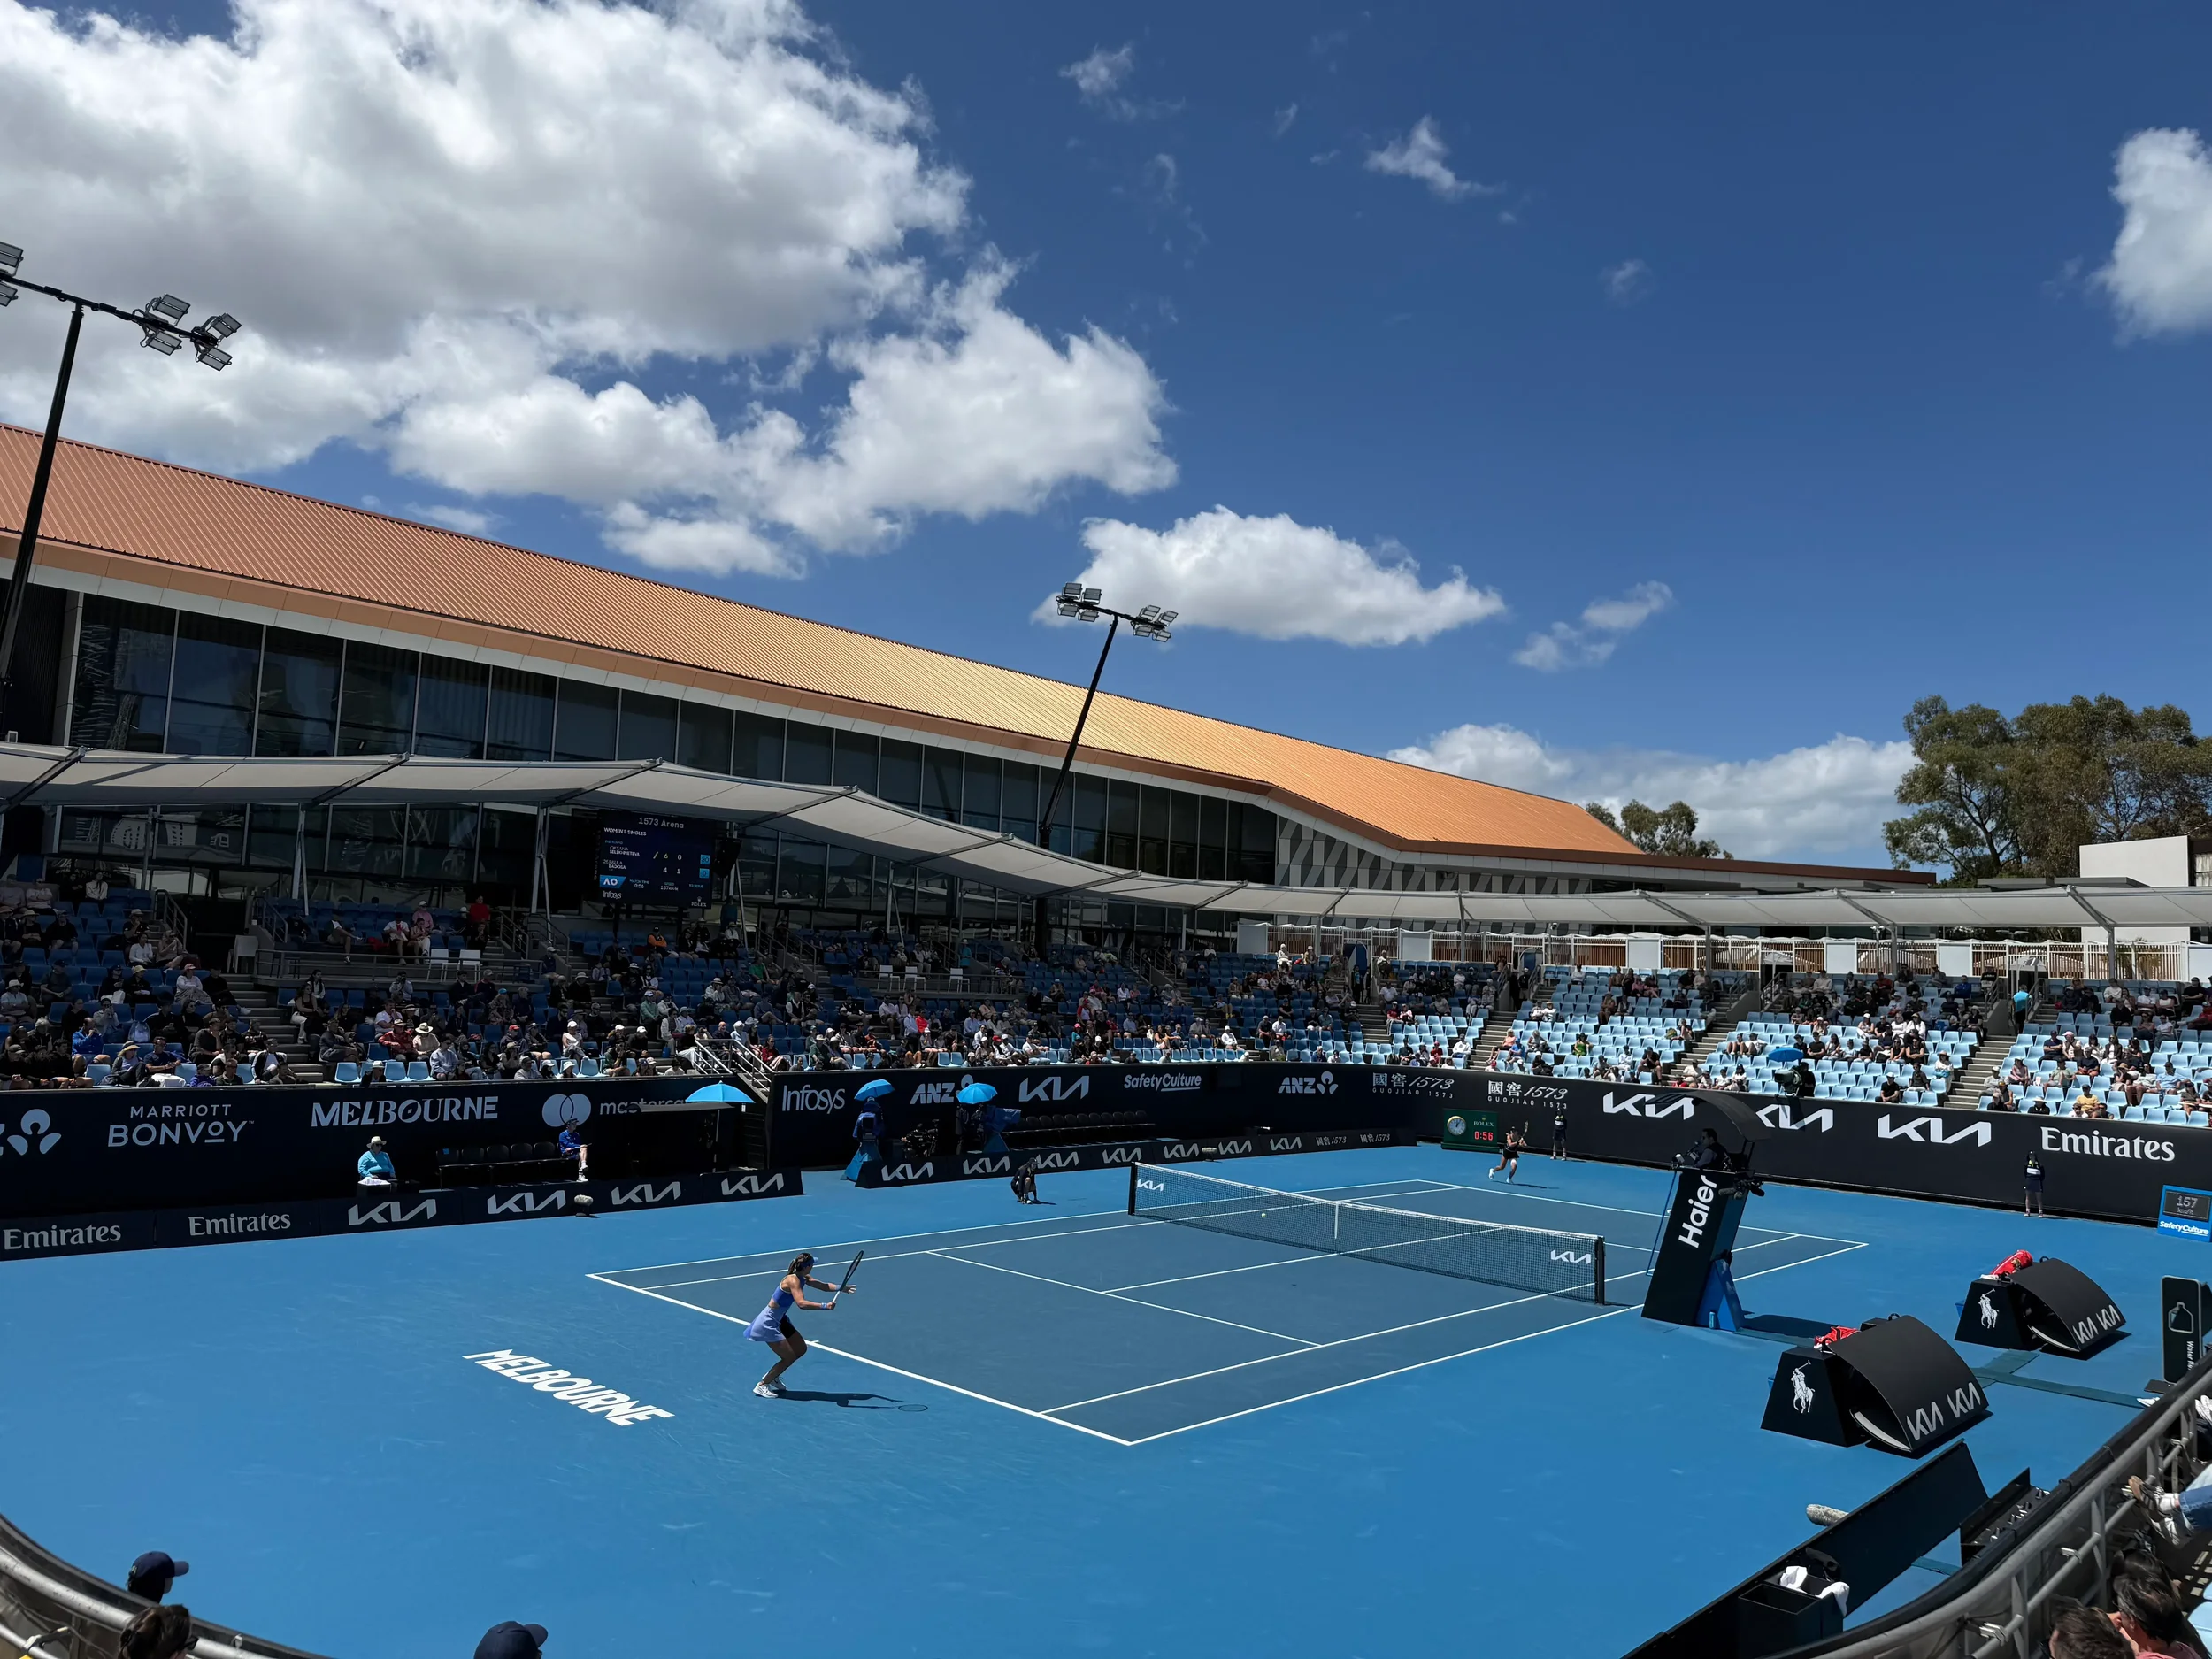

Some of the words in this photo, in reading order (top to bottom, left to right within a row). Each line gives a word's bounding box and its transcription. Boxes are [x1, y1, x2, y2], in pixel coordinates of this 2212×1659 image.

[638, 817, 659, 826] 1573
[660, 819, 684, 829] Arena
[603, 890, 622, 900] Infosys
[1018, 1075, 1090, 1102] KIA
[1124, 1071, 1202, 1093] SafetyCulture
[1278, 1076, 1317, 1094] ANZ
[781, 1083, 846, 1115] Infosys
[910, 1082, 956, 1105] ANZ
[1428, 1090, 1454, 1099] 1573
[1487, 1095, 1535, 1106] GUOJIAO
[1542, 1101, 1568, 1110] 1573
[130, 1104, 232, 1118] MARRIOTT
[311, 1094, 499, 1127] MELBOURNE
[1602, 1091, 1694, 1121] KIA
[1473, 1130, 1494, 1142] 0:56
[1877, 1113, 1992, 1148] KIA
[1102, 1146, 1142, 1164] KIA
[1163, 1142, 1200, 1160] KIA
[1217, 1139, 1252, 1156] KIA
[1269, 1136, 1302, 1152] KIA
[2039, 1126, 2176, 1163] Emirates
[881, 1161, 934, 1182] KIA
[962, 1156, 1011, 1175] KIA
[611, 1180, 681, 1206] KIA
[720, 1172, 785, 1196] KIA
[1136, 1178, 1165, 1193] KIA
[348, 1198, 438, 1226] KIA
[487, 1189, 566, 1216] KIA
[1678, 1174, 1718, 1249] Haier
[2176, 1194, 2199, 1209] 157
[188, 1211, 292, 1237] Emirates
[2159, 1220, 2210, 1237] SafetyCulture
[2, 1222, 122, 1251] Emirates
[1549, 1248, 1592, 1266] KIA
[2097, 1303, 2121, 1331] KIA
[2072, 1316, 2098, 1344] KIA
[2185, 1340, 2195, 1360] Water
[461, 1348, 676, 1426] MELBOURNE
[1947, 1381, 1982, 1418] KIA
[1907, 1399, 1944, 1441] KIA
